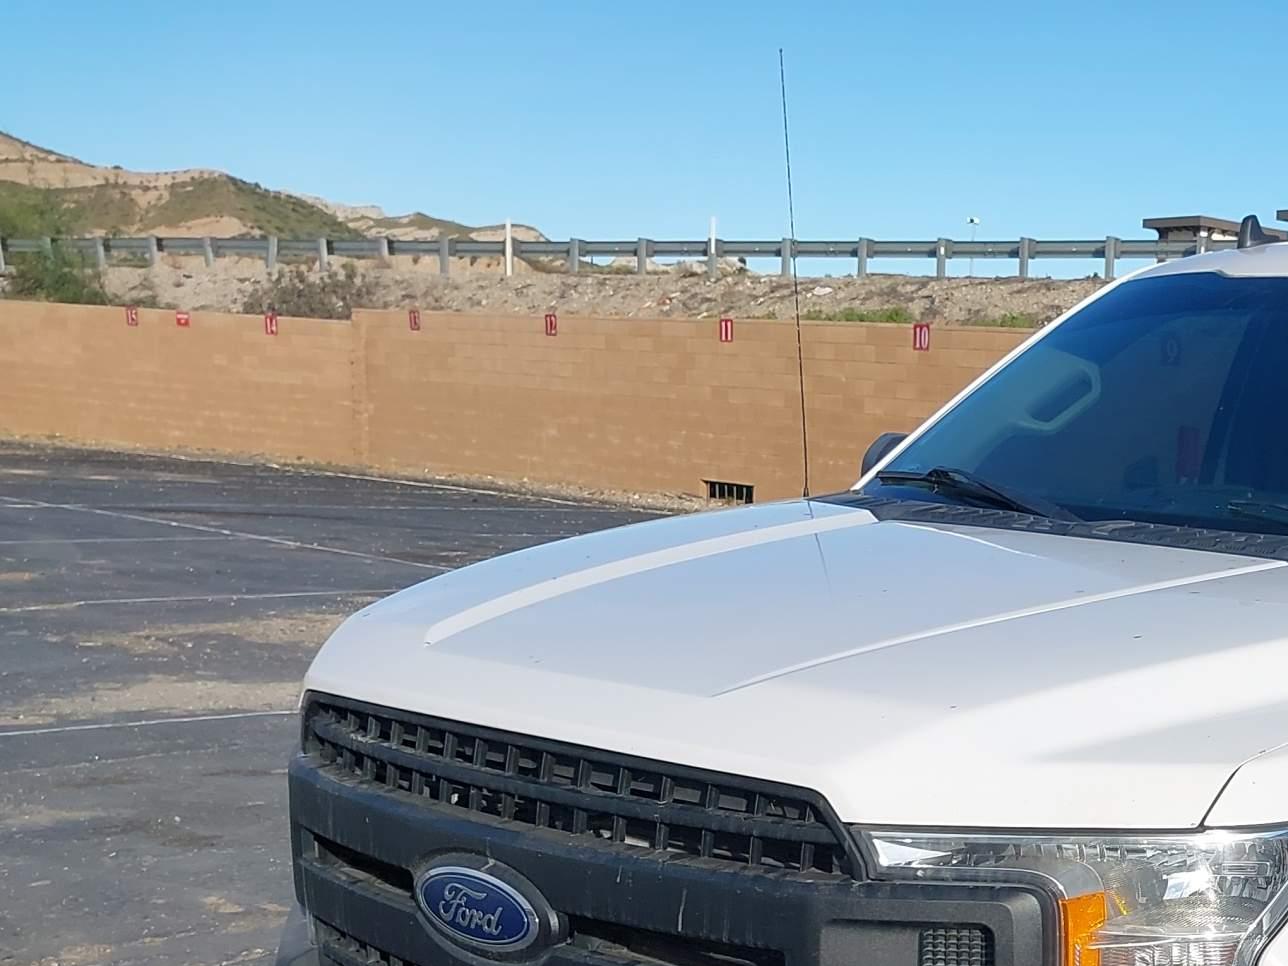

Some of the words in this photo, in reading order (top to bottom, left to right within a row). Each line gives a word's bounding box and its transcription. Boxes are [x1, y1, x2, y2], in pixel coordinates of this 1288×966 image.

[721, 320, 732, 341] 11
[915, 326, 929, 350] 10
[438, 882, 503, 936] Ford
